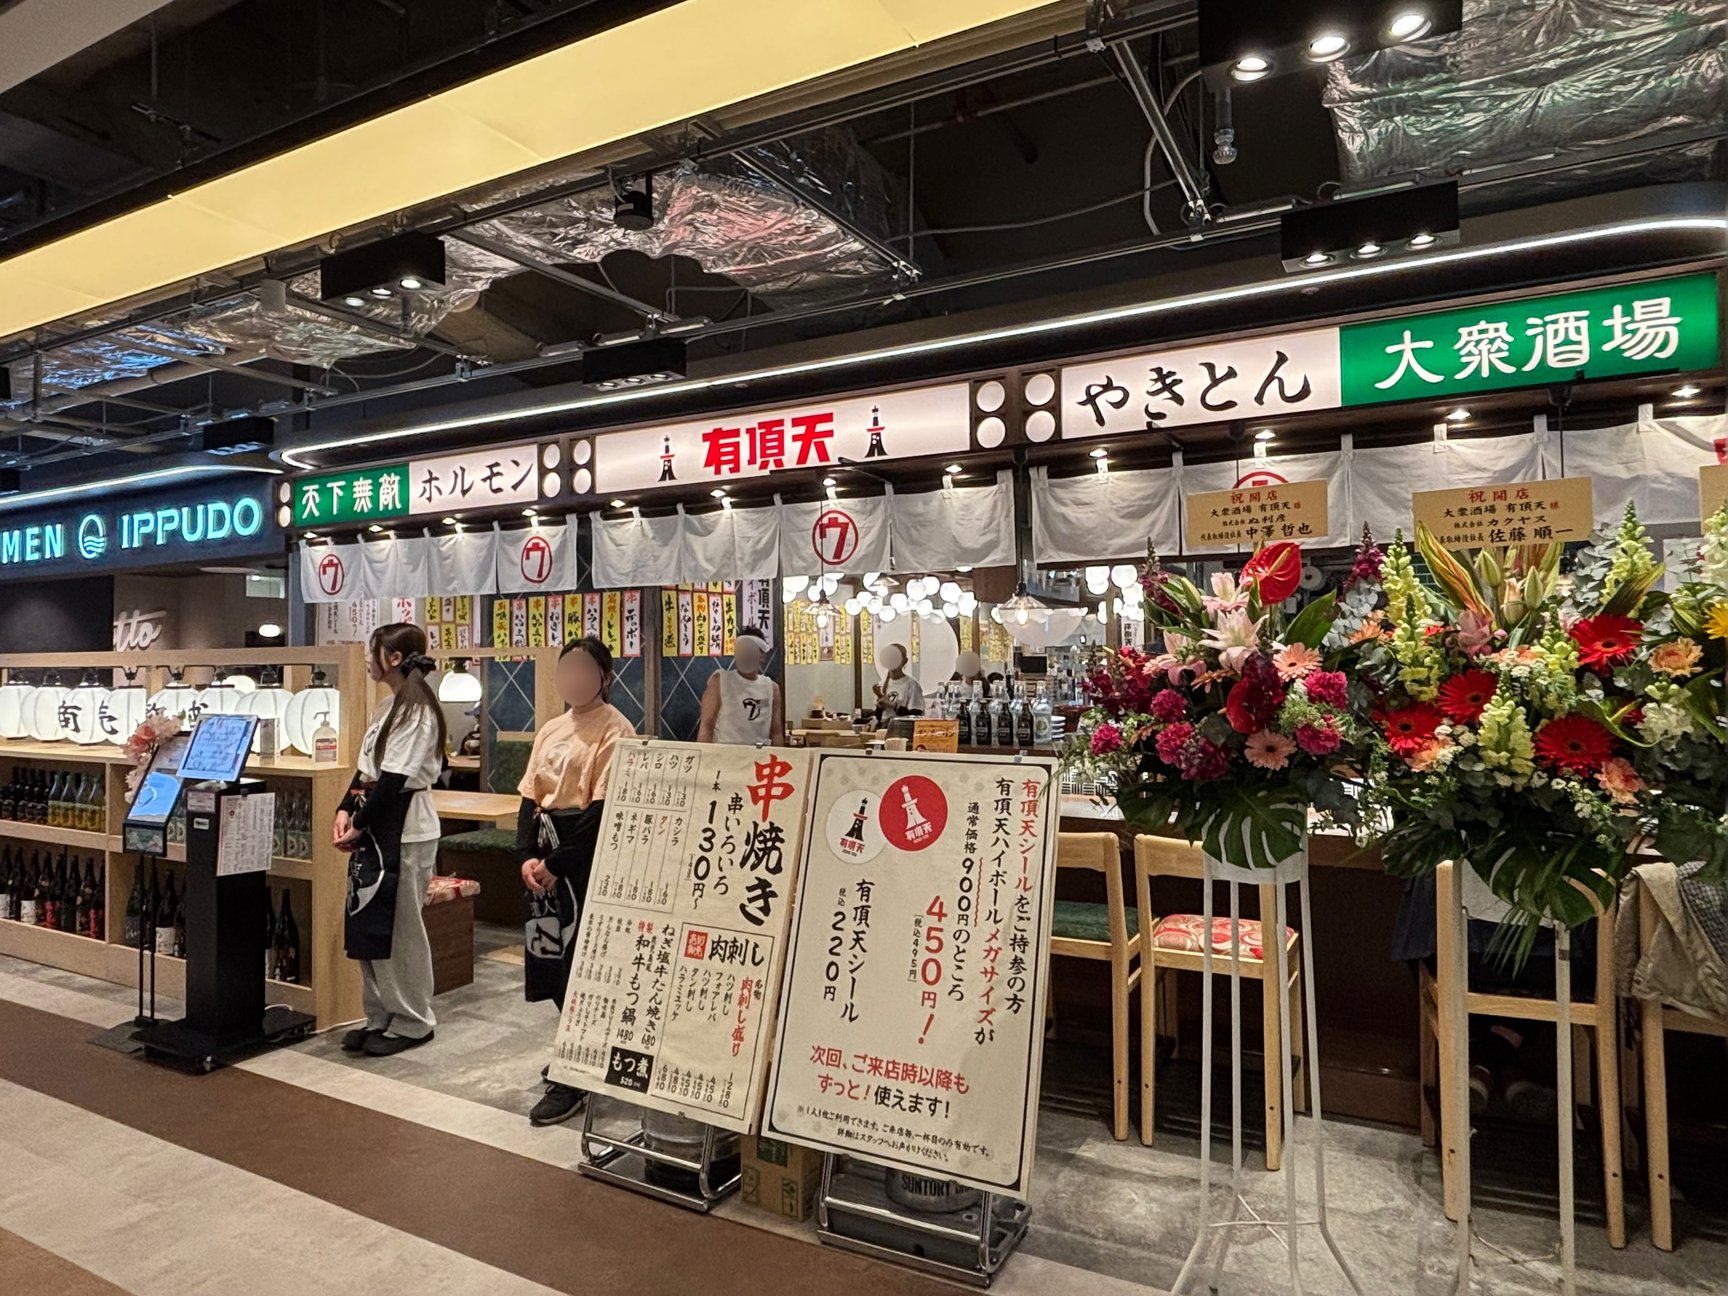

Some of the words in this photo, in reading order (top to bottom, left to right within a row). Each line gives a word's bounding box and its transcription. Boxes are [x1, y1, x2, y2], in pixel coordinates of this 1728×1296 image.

[1374, 297, 1683, 389] 大衆酒場
[1077, 351, 1312, 427] やきとん
[702, 412, 835, 476] 有頂天
[302, 473, 402, 520] 天下無敵
[420, 459, 534, 503] ホルモン
[1229, 490, 1278, 504] 祝開店
[1468, 488, 1530, 504] 祝開店
[1210, 504, 1251, 518] 大衆酒場
[1259, 501, 1291, 513] 有頂天
[1443, 504, 1496, 518] 大衆酒場
[1505, 500, 1547, 513] 有頂天
[1487, 515, 1547, 527] カクヤス
[2, 523, 63, 564] MEN
[121, 497, 261, 549] IPPUDO
[1281, 522, 1312, 537] 哲也
[1488, 527, 1527, 544] 佐藤
[1533, 526, 1574, 540] 順一
[640, 752, 649, 769] レバ
[654, 753, 664, 769] シロ
[669, 754, 679, 769] ハツ
[683, 755, 695, 773] ガツ
[626, 812, 638, 844] ネギマ
[658, 815, 668, 835] タン
[671, 817, 683, 846] カシラ
[739, 753, 795, 926] 串焼き
[713, 792, 744, 895] 串いろいろ
[948, 802, 980, 1002] 通常価格900円のところ
[974, 777, 1014, 1045] 有頂天ハイボールメガサイズが
[1004, 778, 1041, 1015] 有頂天シールをご持参の方
[708, 934, 764, 967] 肉刺し
[840, 878, 875, 1023] 有頂天シール
[620, 934, 650, 1027] 和牛もつ鍋
[644, 923, 675, 1033] ねぎ塩牛たん焼き
[918, 895, 948, 1045] 450円！
[612, 1052, 649, 1079] もつ煮
[810, 1045, 970, 1095] 次回、ご来店時以降も
[902, 1173, 950, 1197] SUNTORY
